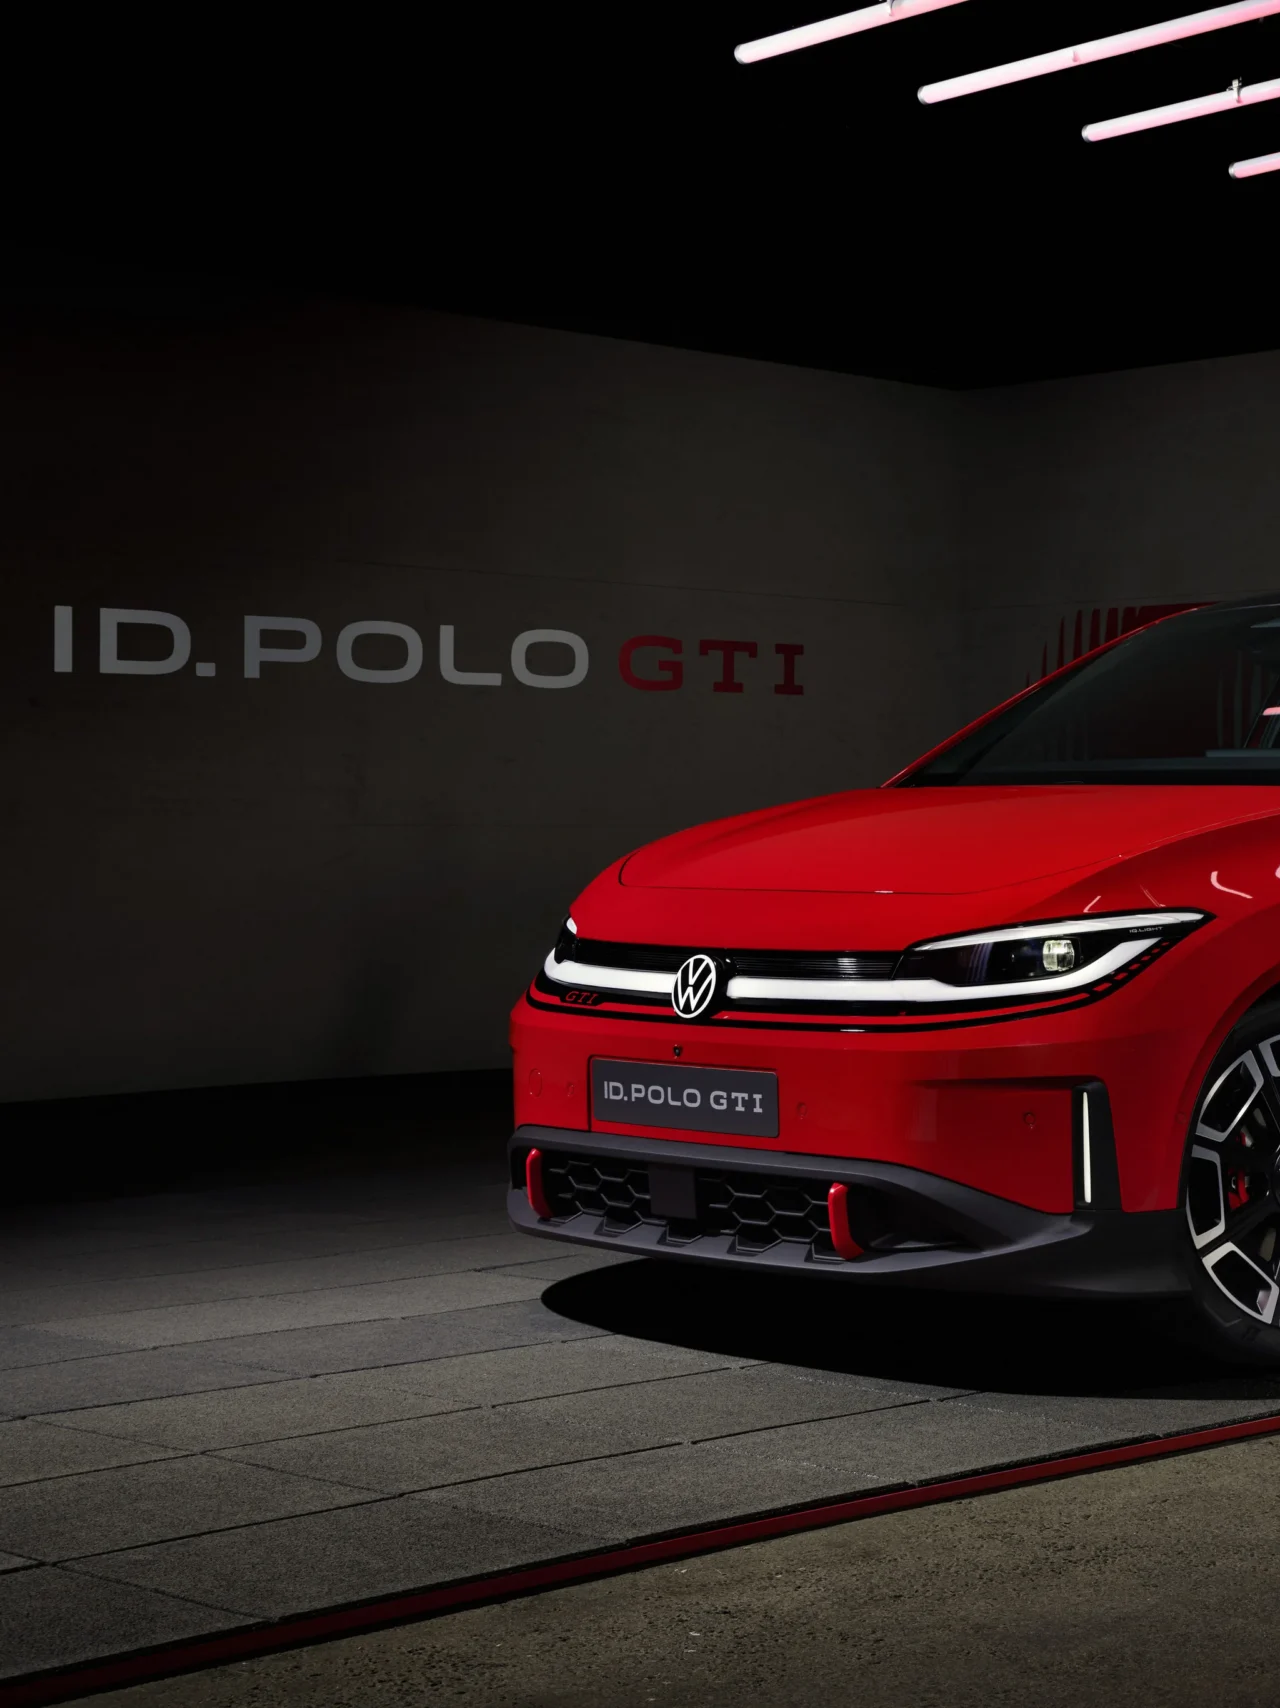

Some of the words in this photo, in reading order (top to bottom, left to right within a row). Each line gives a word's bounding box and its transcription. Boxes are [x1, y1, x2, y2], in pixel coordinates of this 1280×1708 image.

[618, 635, 805, 696] GTI
[565, 990, 599, 1004] GTI
[709, 1090, 763, 1113] GTI
